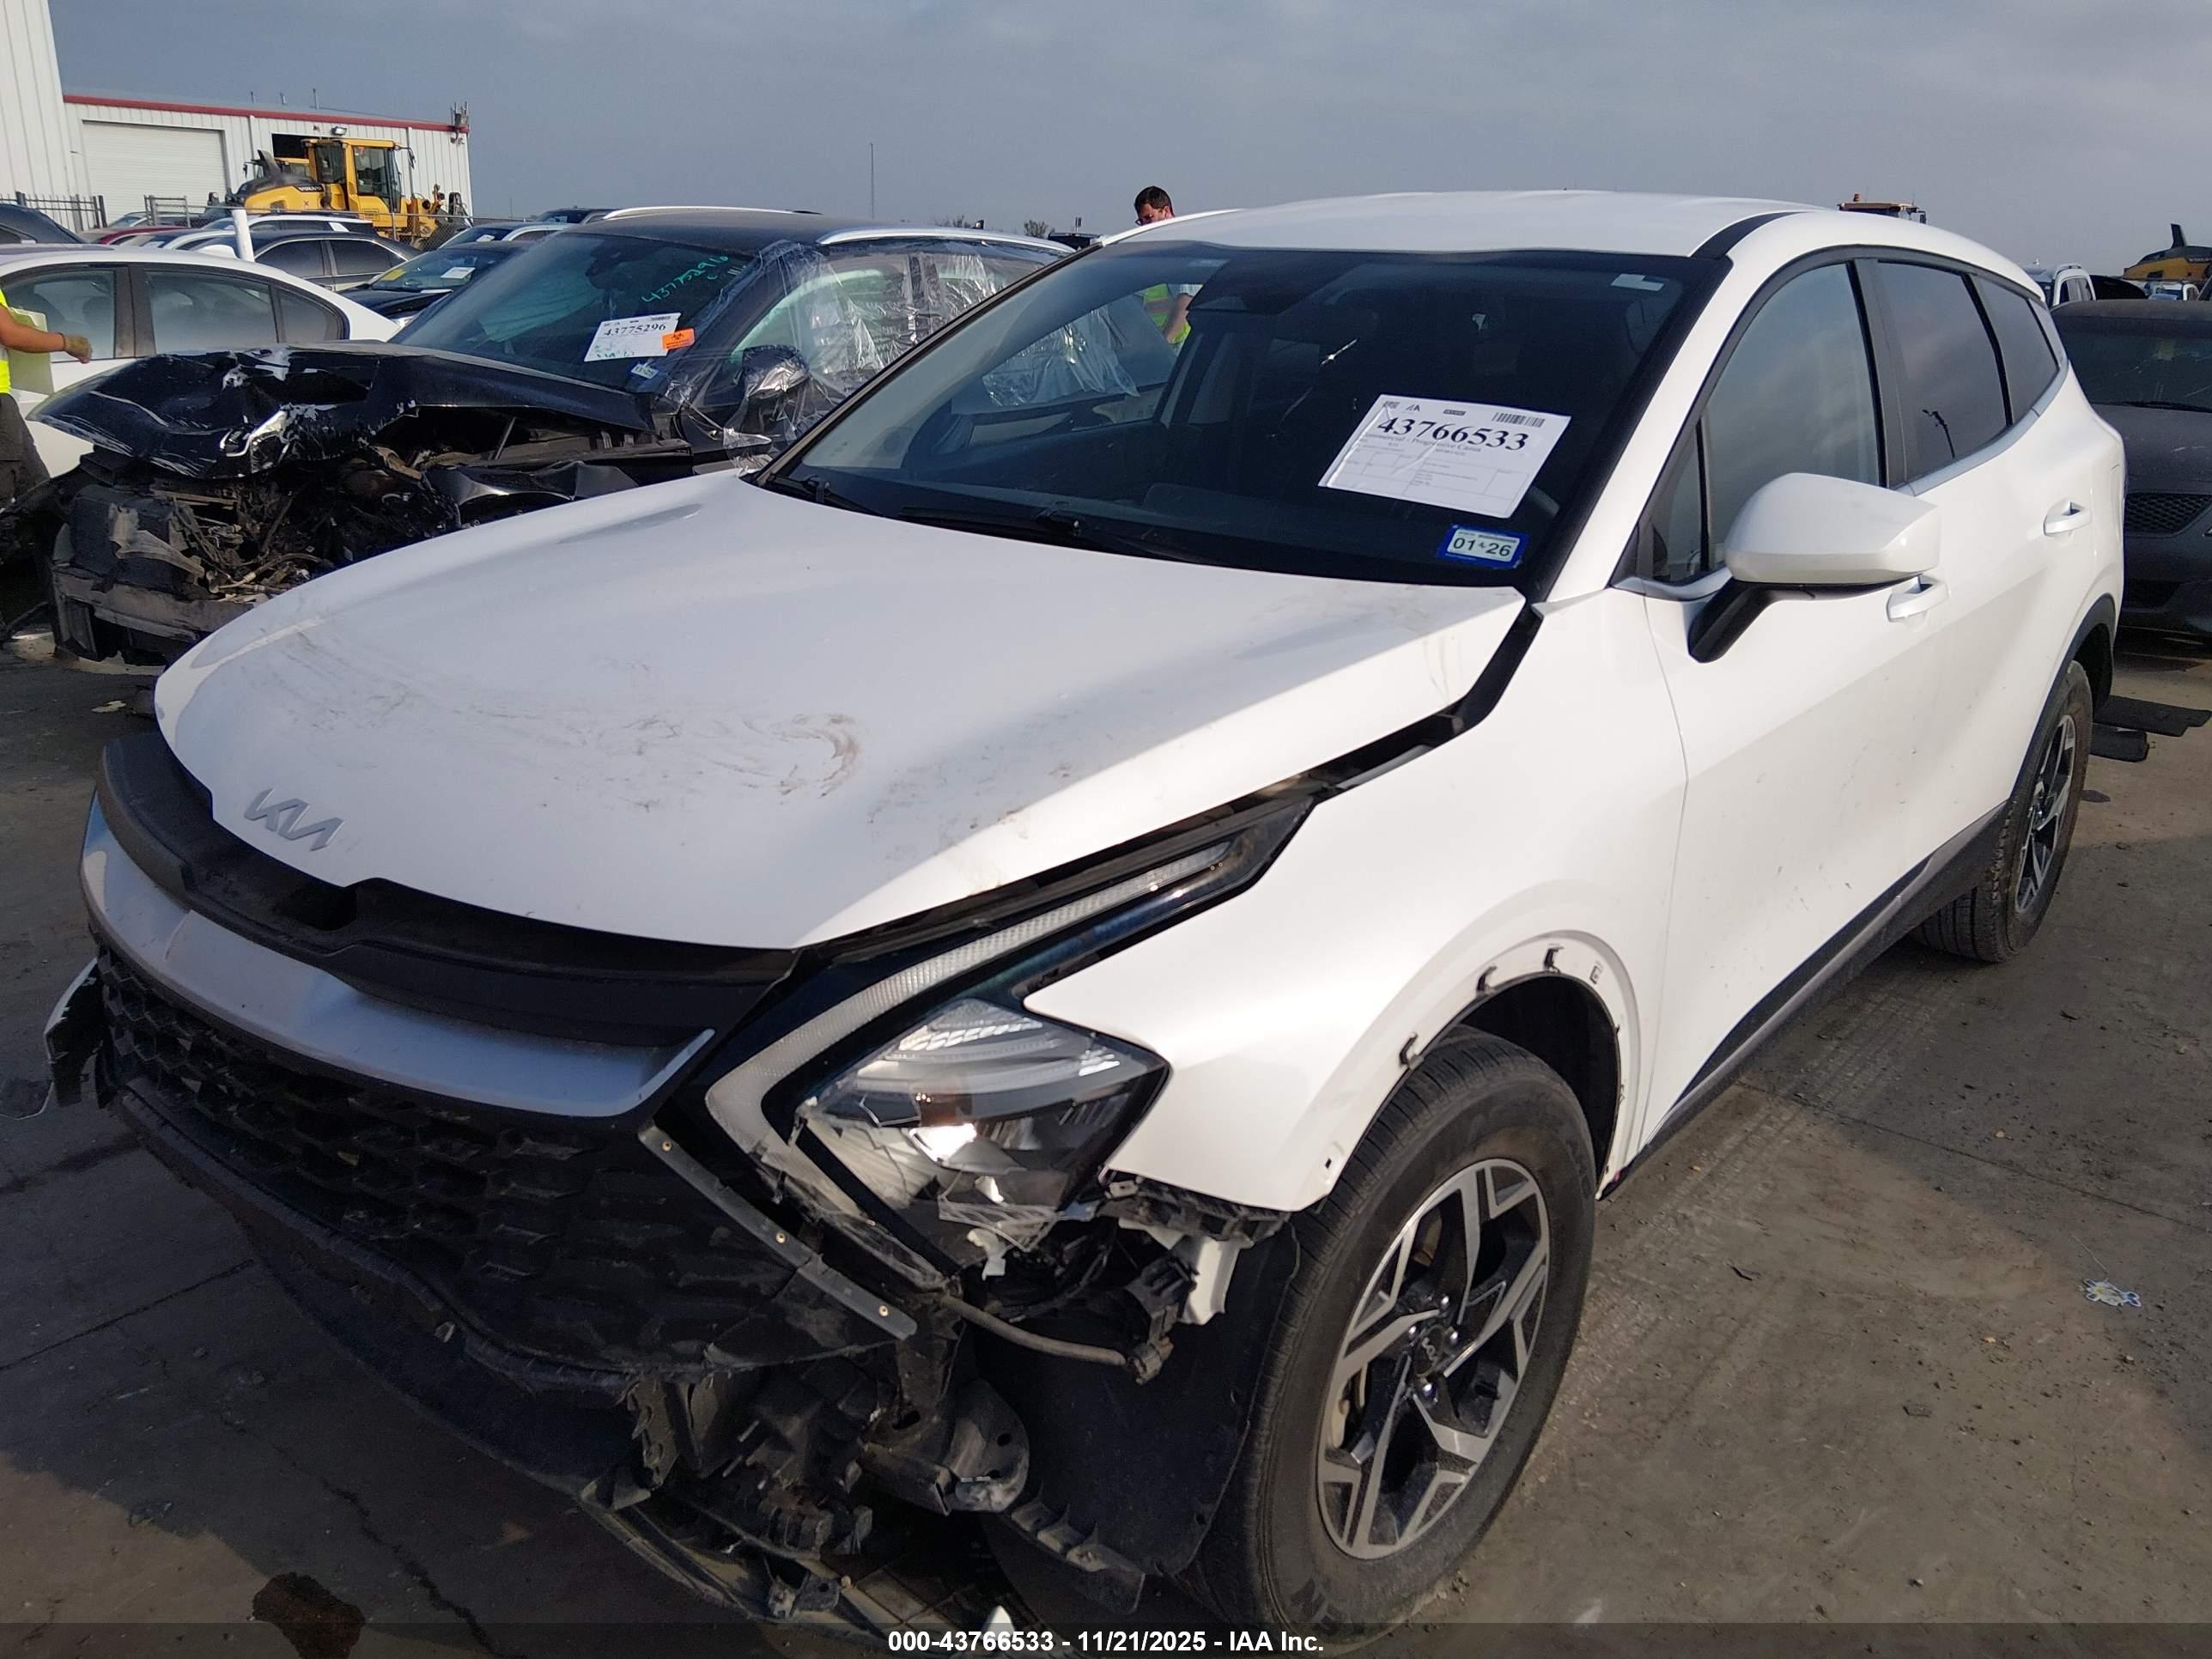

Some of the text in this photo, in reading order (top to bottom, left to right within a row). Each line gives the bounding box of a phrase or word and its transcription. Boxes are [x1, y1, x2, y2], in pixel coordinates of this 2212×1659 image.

[604, 322, 666, 337] 43775296
[1376, 416, 1529, 451] 43766533
[1453, 538, 1512, 557] 01 26
